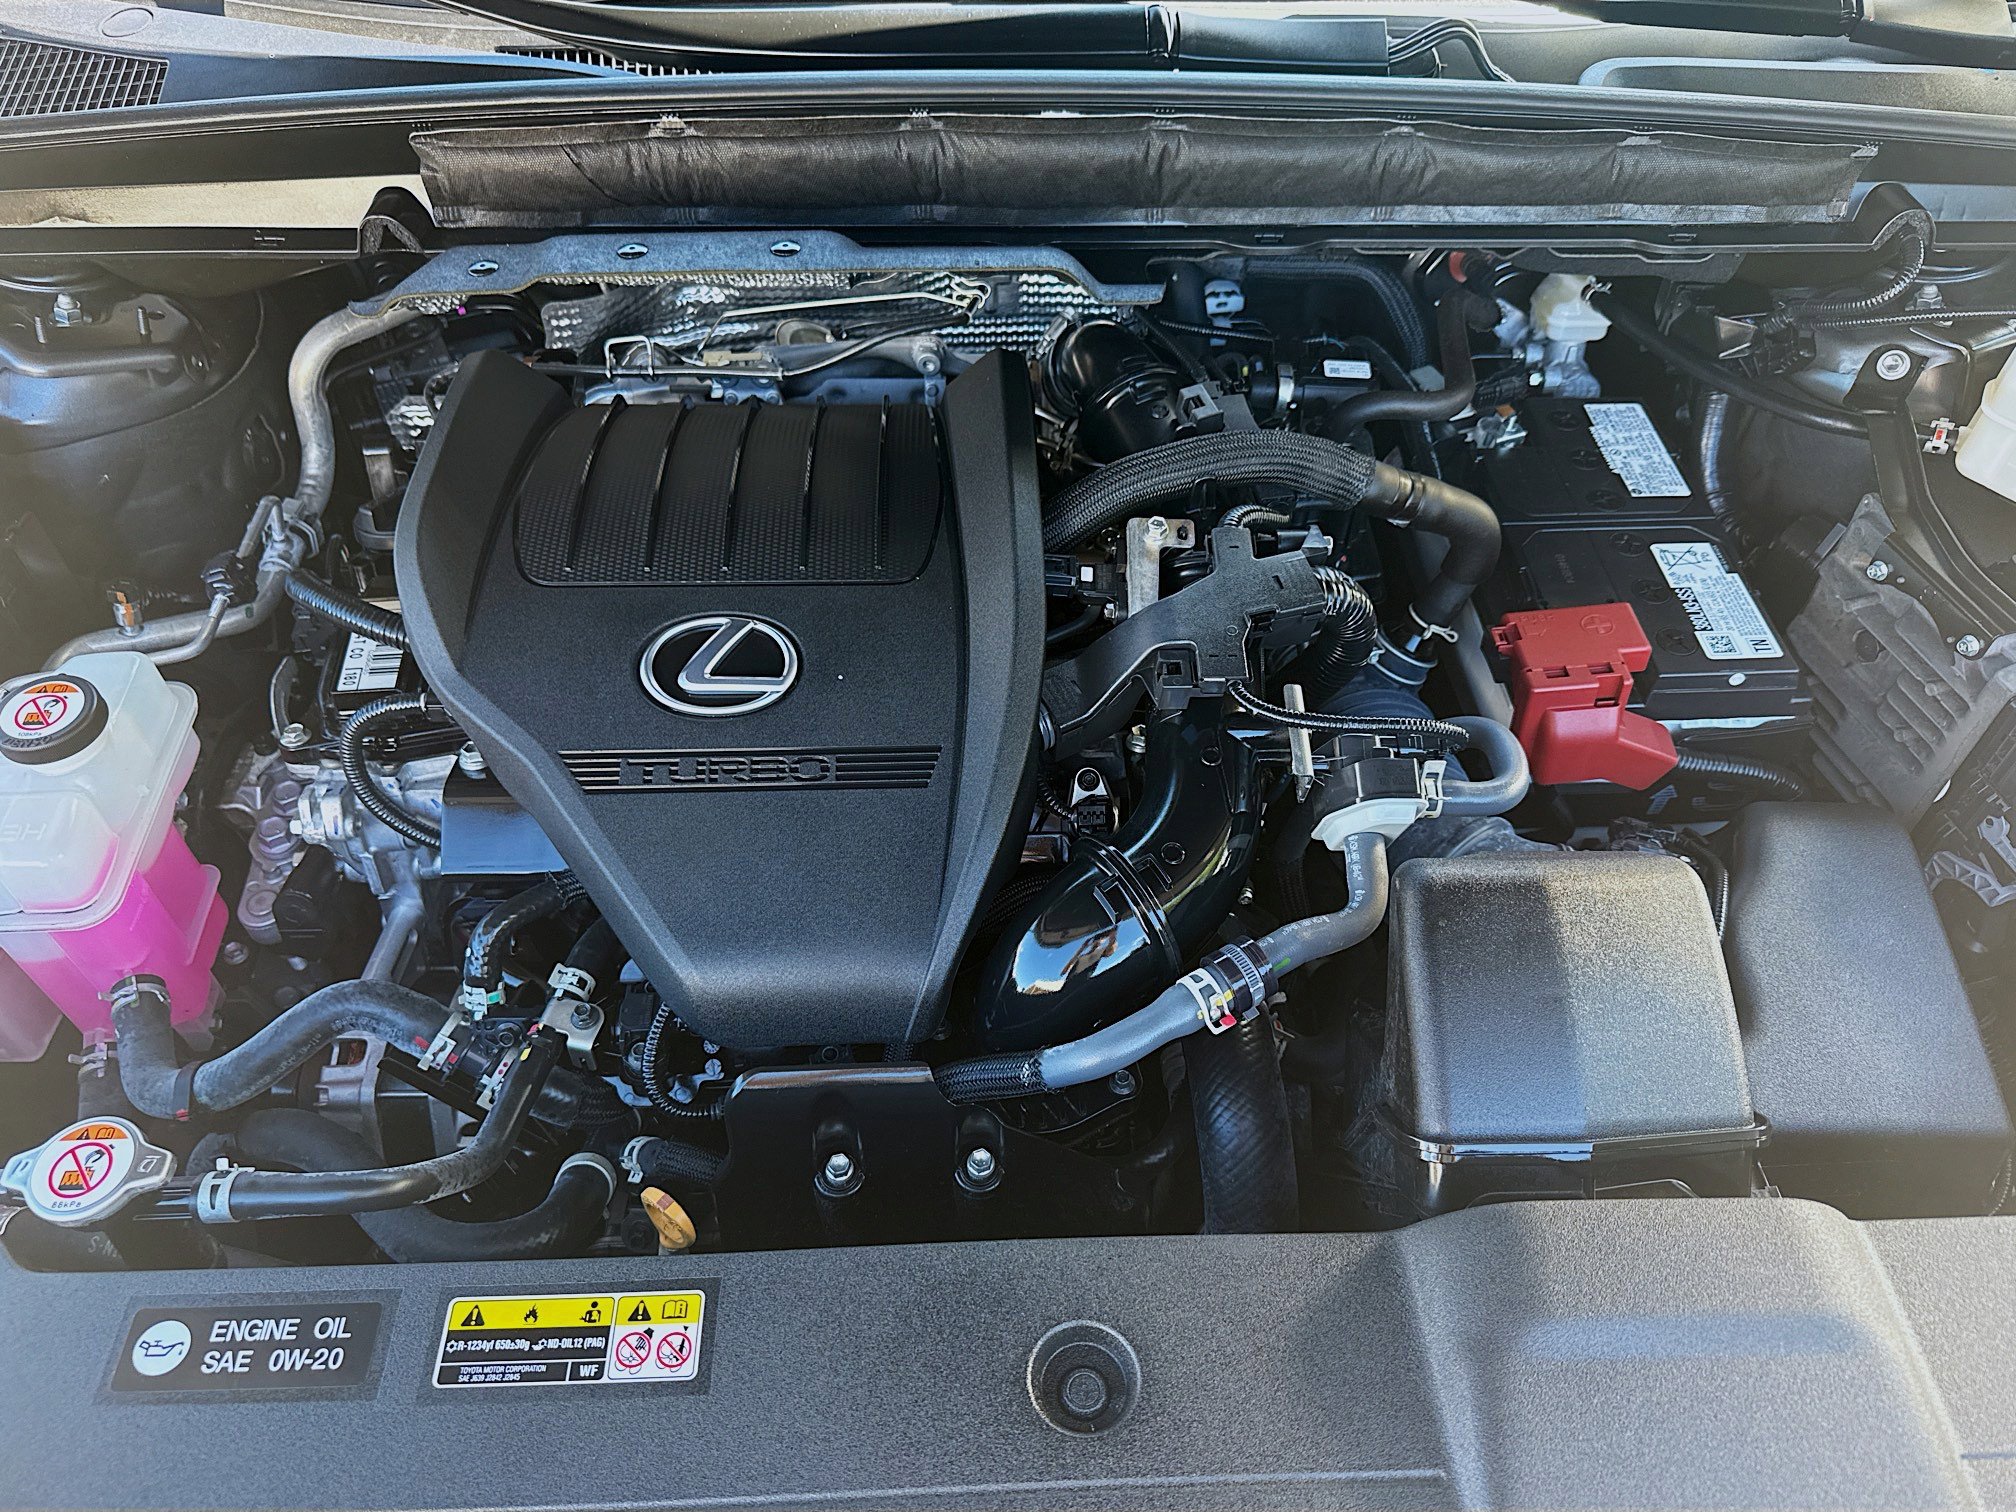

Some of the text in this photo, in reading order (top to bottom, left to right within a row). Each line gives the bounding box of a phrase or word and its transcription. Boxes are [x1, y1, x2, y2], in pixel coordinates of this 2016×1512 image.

[1749, 638, 1772, 653] TN
[342, 671, 357, 686] 180
[626, 753, 831, 784] TURBO
[209, 1316, 351, 1343] ENGINE OIL
[457, 1339, 494, 1353] R-1234yf
[584, 1335, 606, 1350] (PAG)
[200, 1347, 344, 1375] SAE 0W-20
[460, 1364, 547, 1375] TOYOTA MOTOR CORPORATION
[580, 1364, 599, 1377] WF
[458, 1374, 470, 1383] SAE
